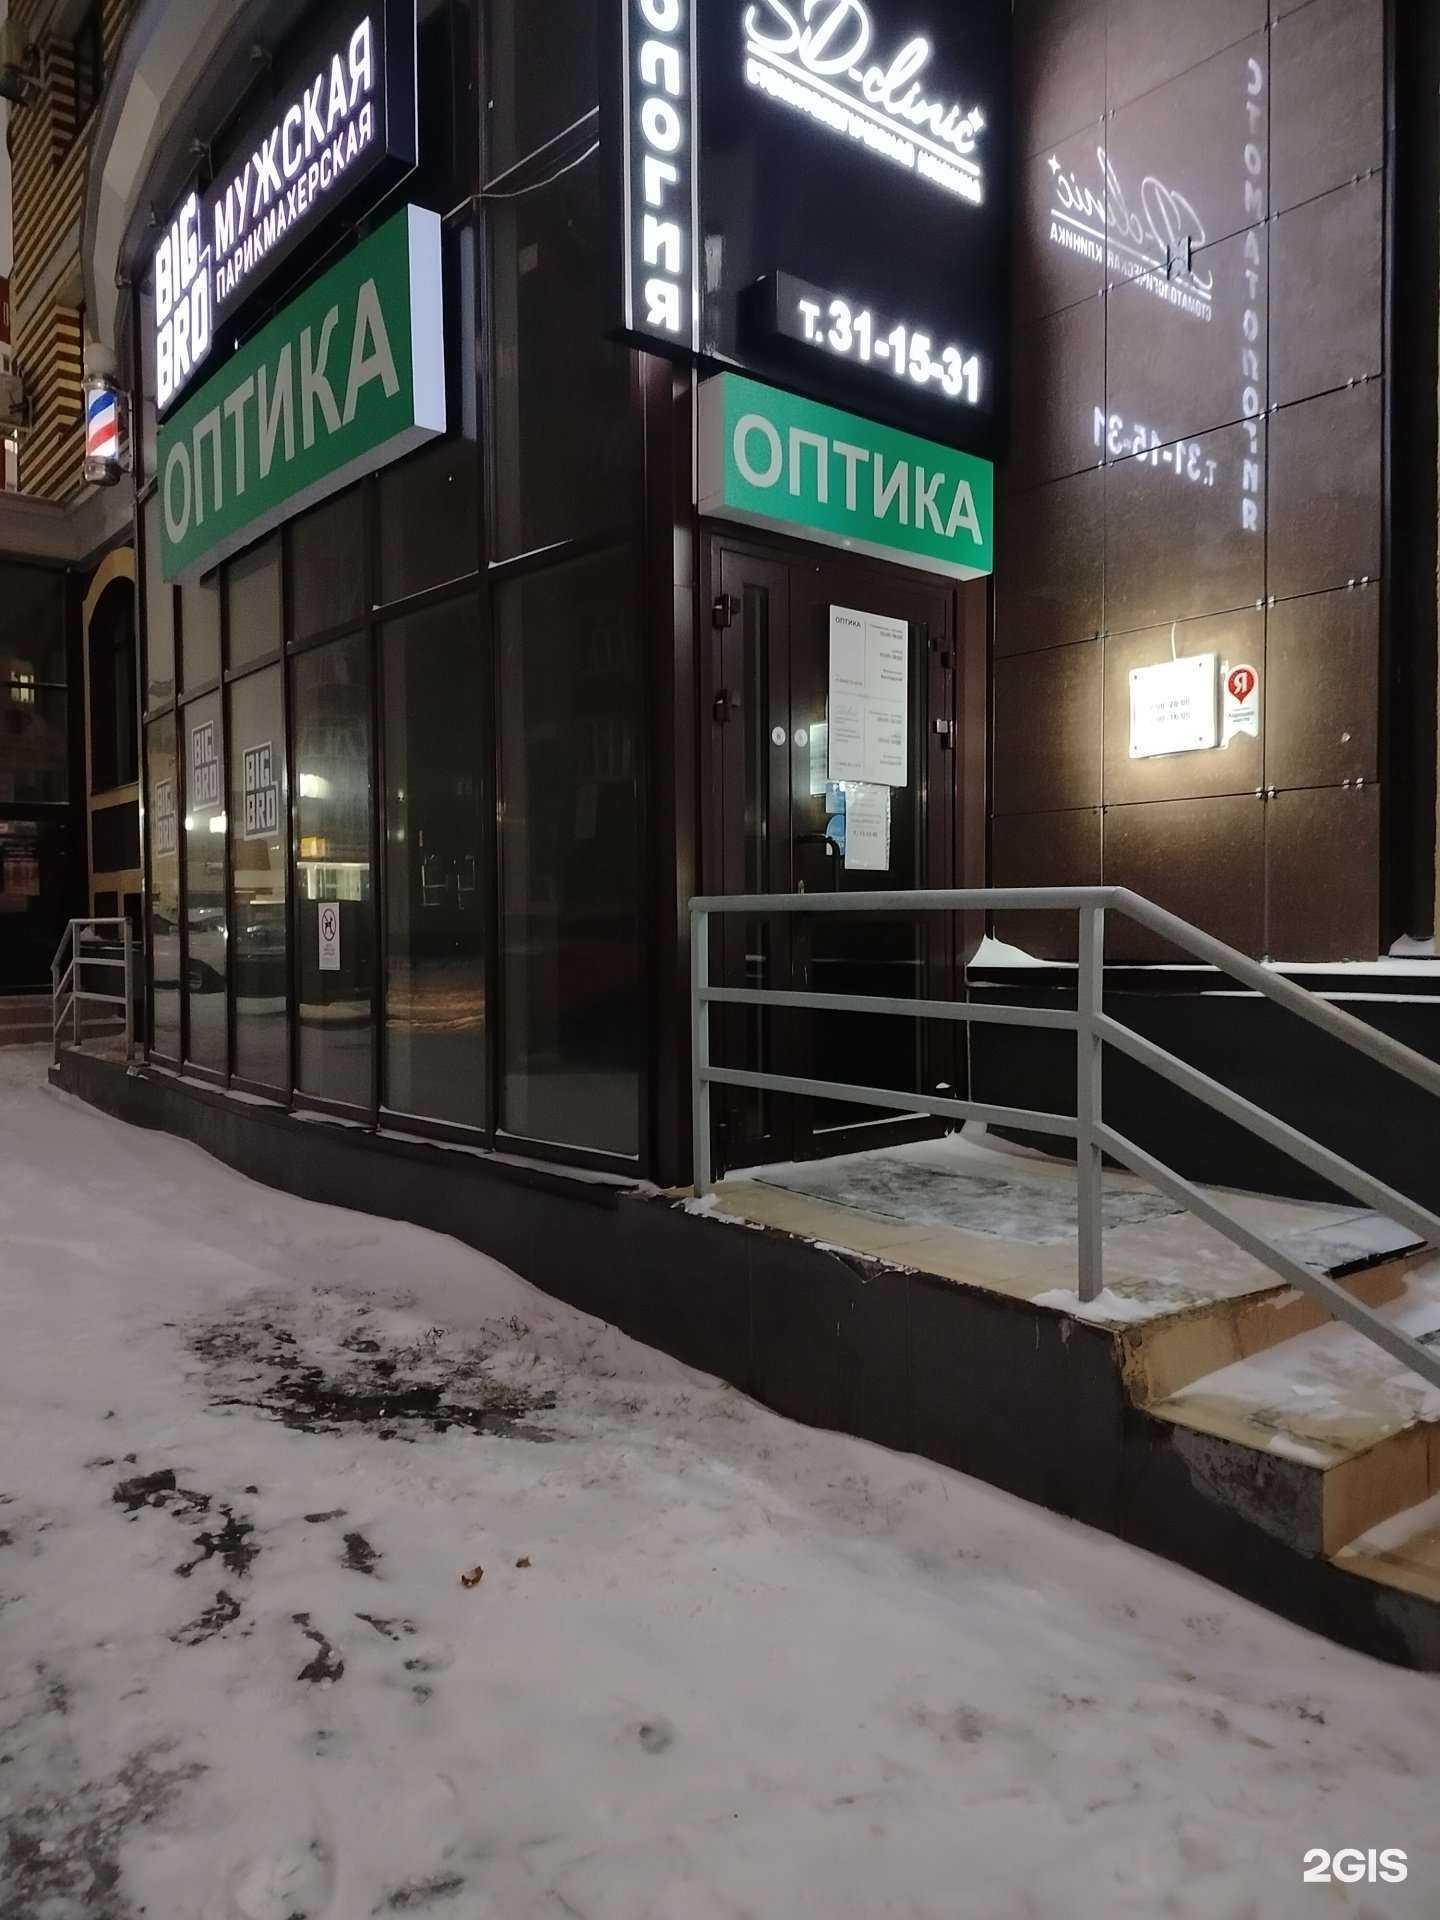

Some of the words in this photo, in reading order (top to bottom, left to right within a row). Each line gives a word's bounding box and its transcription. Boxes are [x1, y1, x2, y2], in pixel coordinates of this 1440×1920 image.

[214, 16, 371, 262] МУЖСКАЯ
[215, 101, 372, 304] ПАРИКМАХЕРСКАЯ
[155, 192, 198, 328] BIG
[156, 266, 209, 410] BRO
[164, 278, 400, 544] ОПТИКА
[733, 413, 984, 546] ОПТИКА
[835, 616, 861, 628] ОПТИКА
[194, 727, 213, 767] BIG
[195, 764, 218, 801] BRO
[246, 749, 271, 791] BIG
[247, 789, 277, 832] BRO
